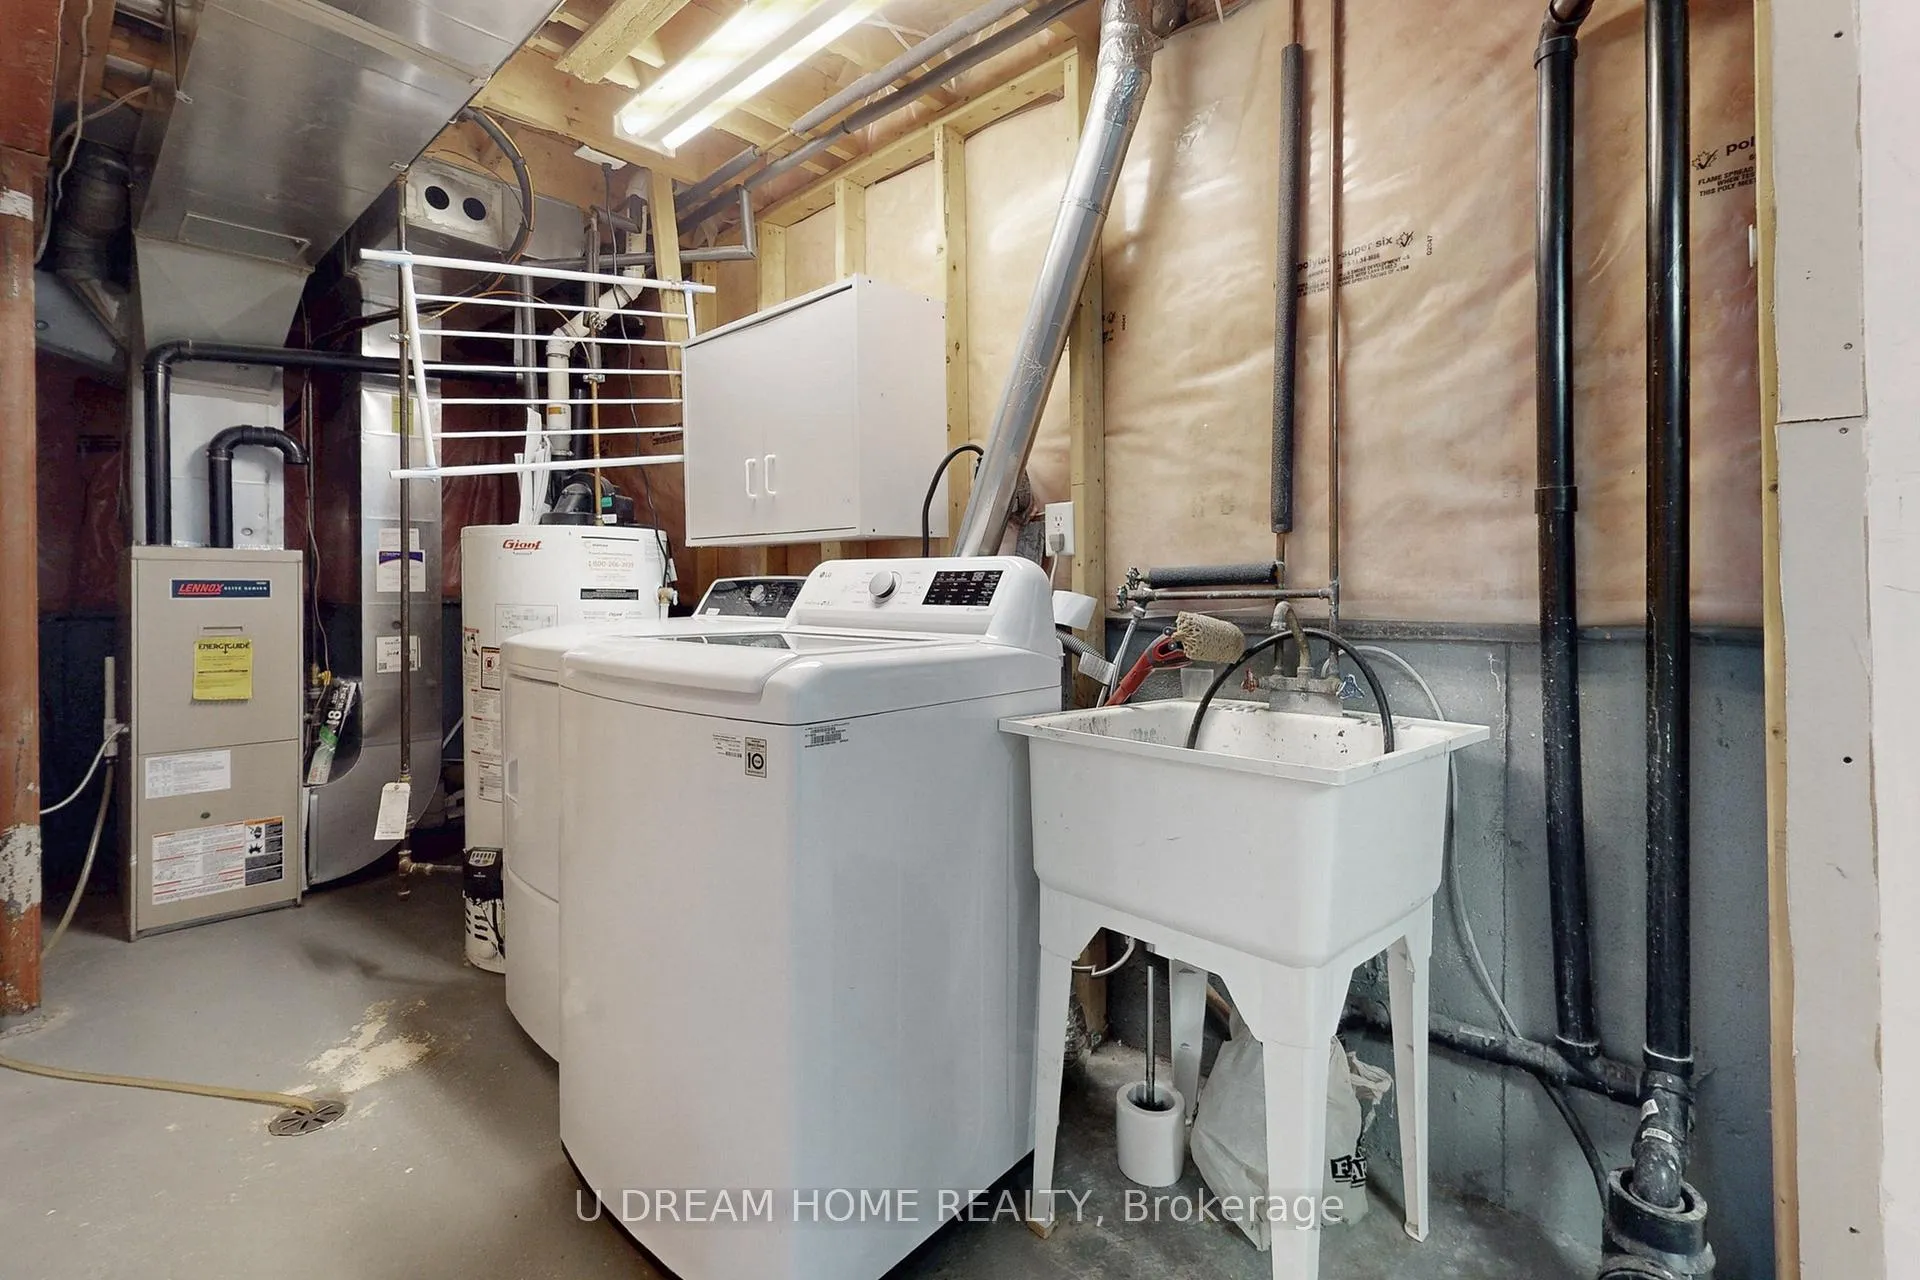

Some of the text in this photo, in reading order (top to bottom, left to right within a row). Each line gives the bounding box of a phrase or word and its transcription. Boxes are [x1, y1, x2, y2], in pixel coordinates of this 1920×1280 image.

[1698, 166, 1754, 186] FLAME SPREAD
[1700, 188, 1716, 197] THIS
[1717, 183, 1736, 193] POLY
[1375, 236, 1393, 248] six
[503, 539, 542, 550] Giant
[179, 583, 224, 592] LENNOX
